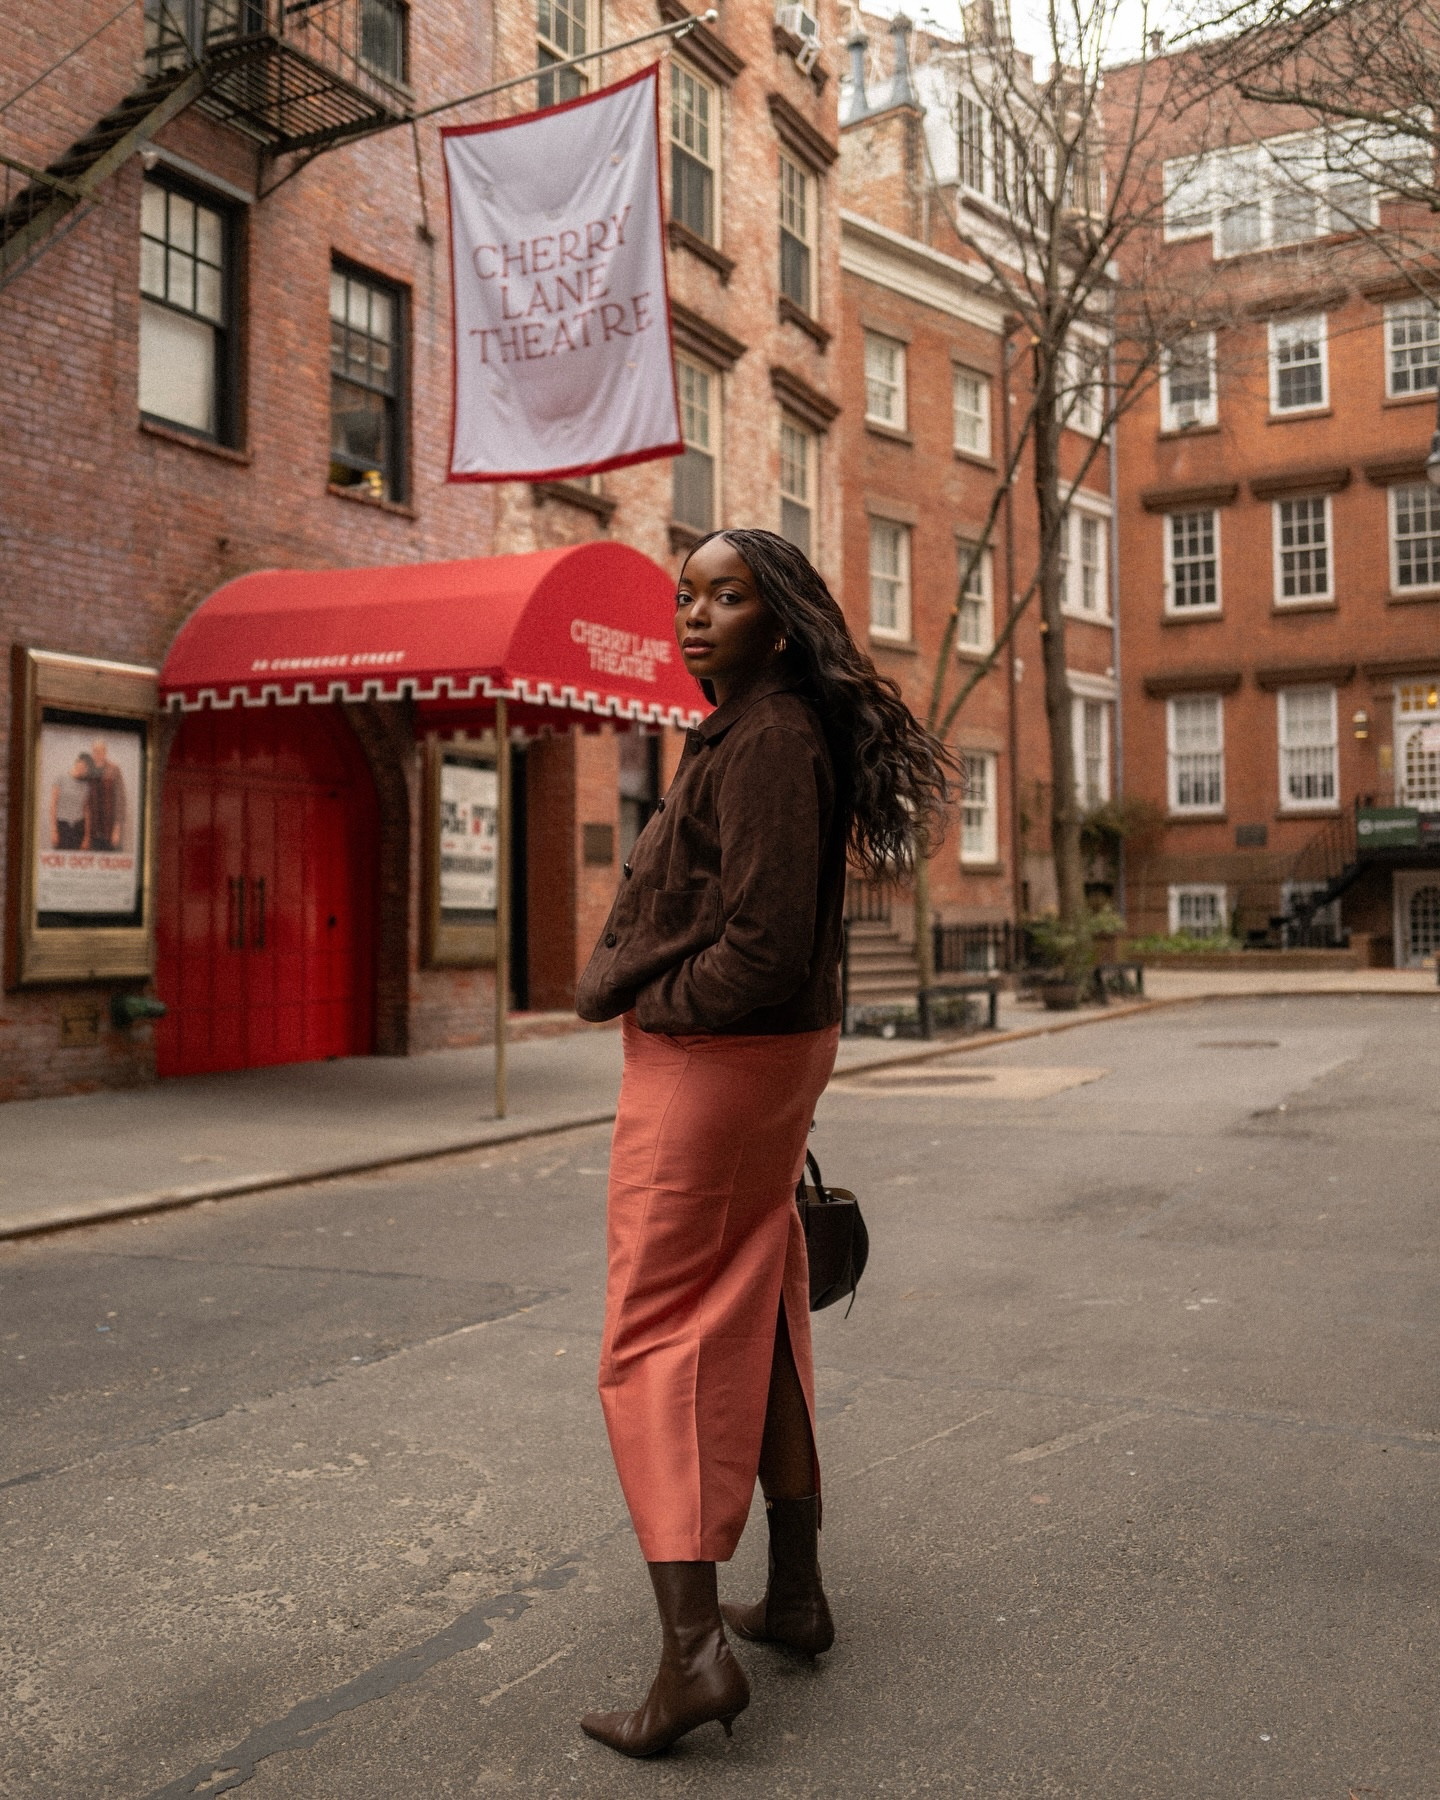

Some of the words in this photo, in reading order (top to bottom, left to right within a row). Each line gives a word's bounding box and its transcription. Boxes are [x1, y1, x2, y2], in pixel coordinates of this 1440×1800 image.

[472, 205, 632, 280] CHERRY
[500, 263, 610, 320] LANE
[468, 292, 653, 364] THEATRE
[570, 619, 634, 653] CHERRY
[632, 634, 672, 664] LANE
[587, 645, 656, 682] THEATRE
